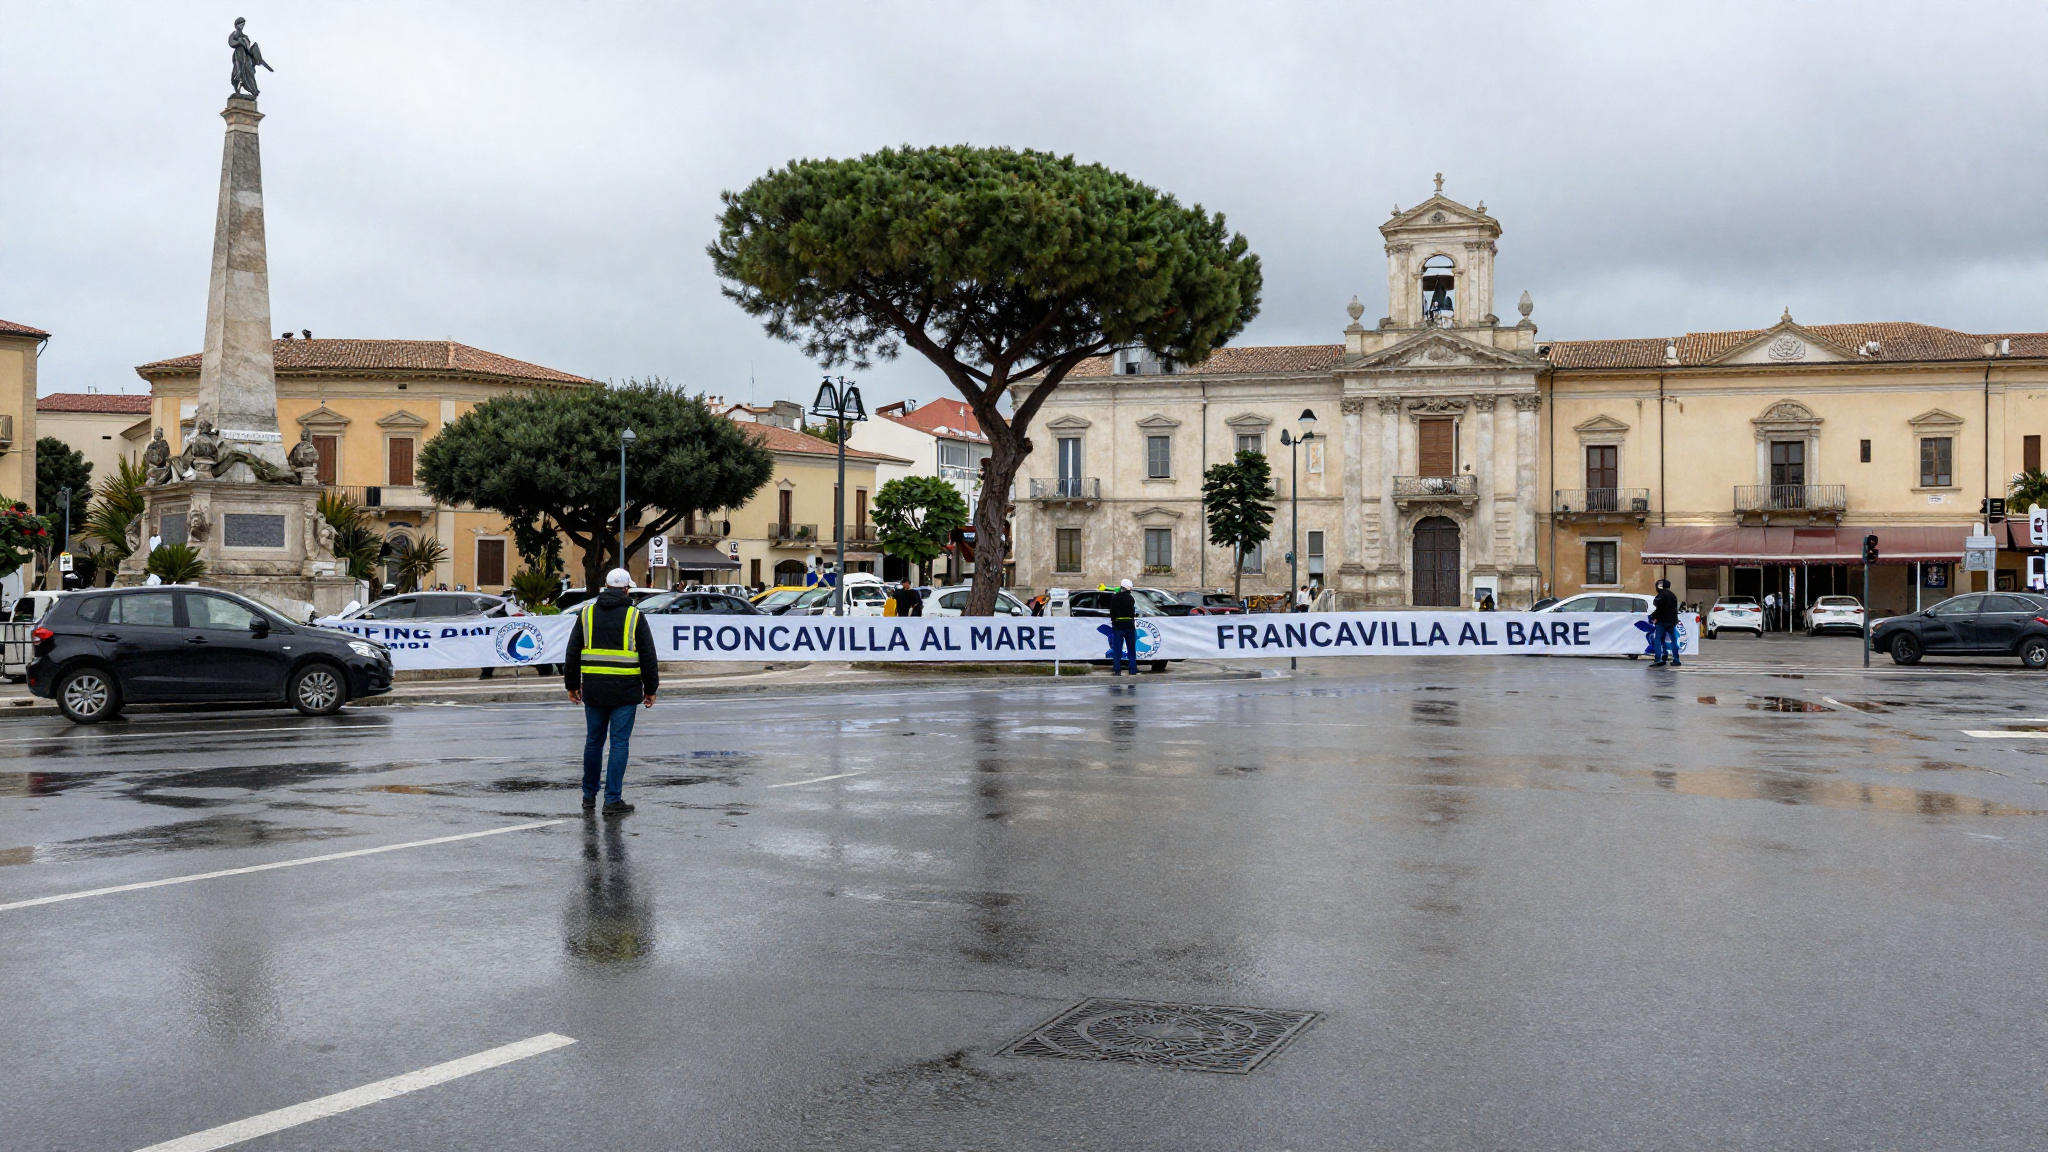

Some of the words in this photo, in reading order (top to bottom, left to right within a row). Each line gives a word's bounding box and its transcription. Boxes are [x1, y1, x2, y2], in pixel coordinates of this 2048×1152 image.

[672, 625, 910, 652] FRONCAVILLA
[919, 625, 961, 652] AL
[970, 625, 1056, 652] MARE
[1217, 620, 1450, 650] FRANCAVILLA
[1458, 620, 1497, 647] AL
[1507, 620, 1592, 647] BARE
